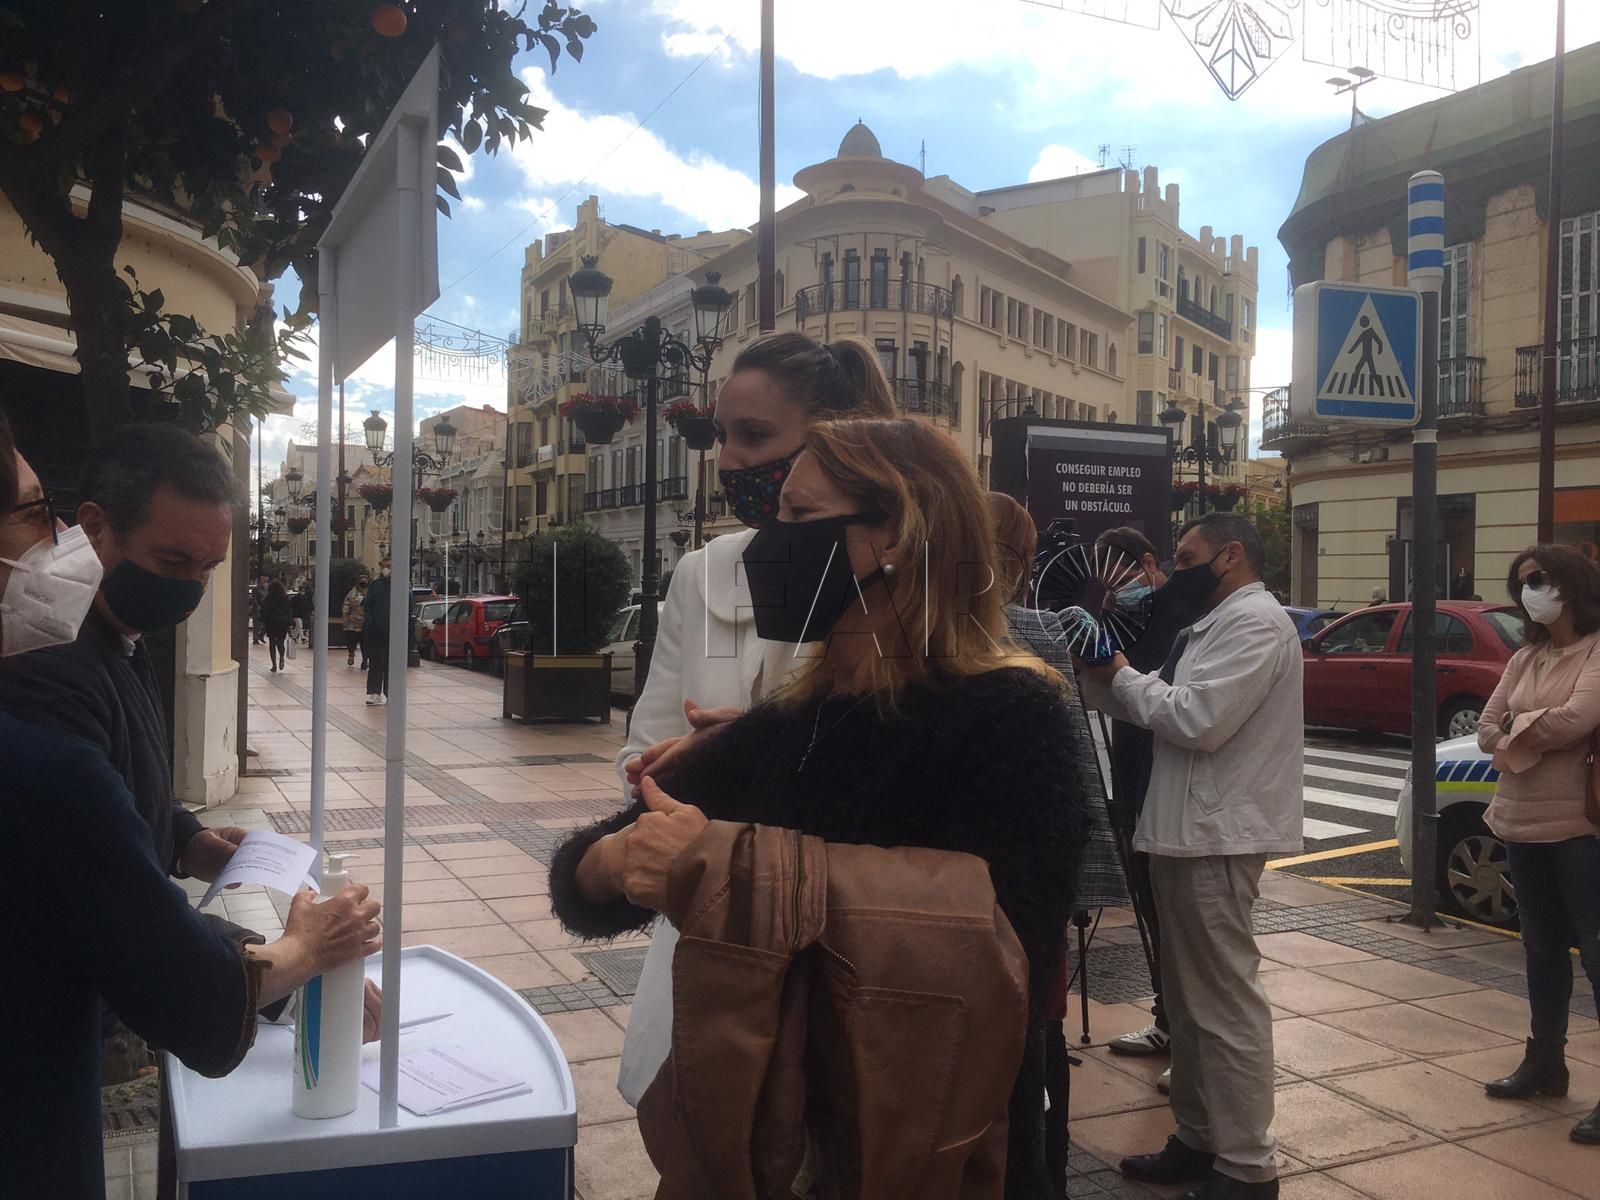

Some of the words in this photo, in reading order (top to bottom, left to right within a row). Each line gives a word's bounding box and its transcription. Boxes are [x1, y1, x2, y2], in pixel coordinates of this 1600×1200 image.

[1055, 463, 1106, 476] CONSEGUIR
[1108, 466, 1142, 478] EMPLEO
[1062, 481, 1076, 492] NO
[1078, 481, 1115, 495] DEBERÍA
[1117, 484, 1133, 496] SER
[1065, 500, 1078, 511] UN
[1081, 499, 1133, 513] OBSTÁCULO.
